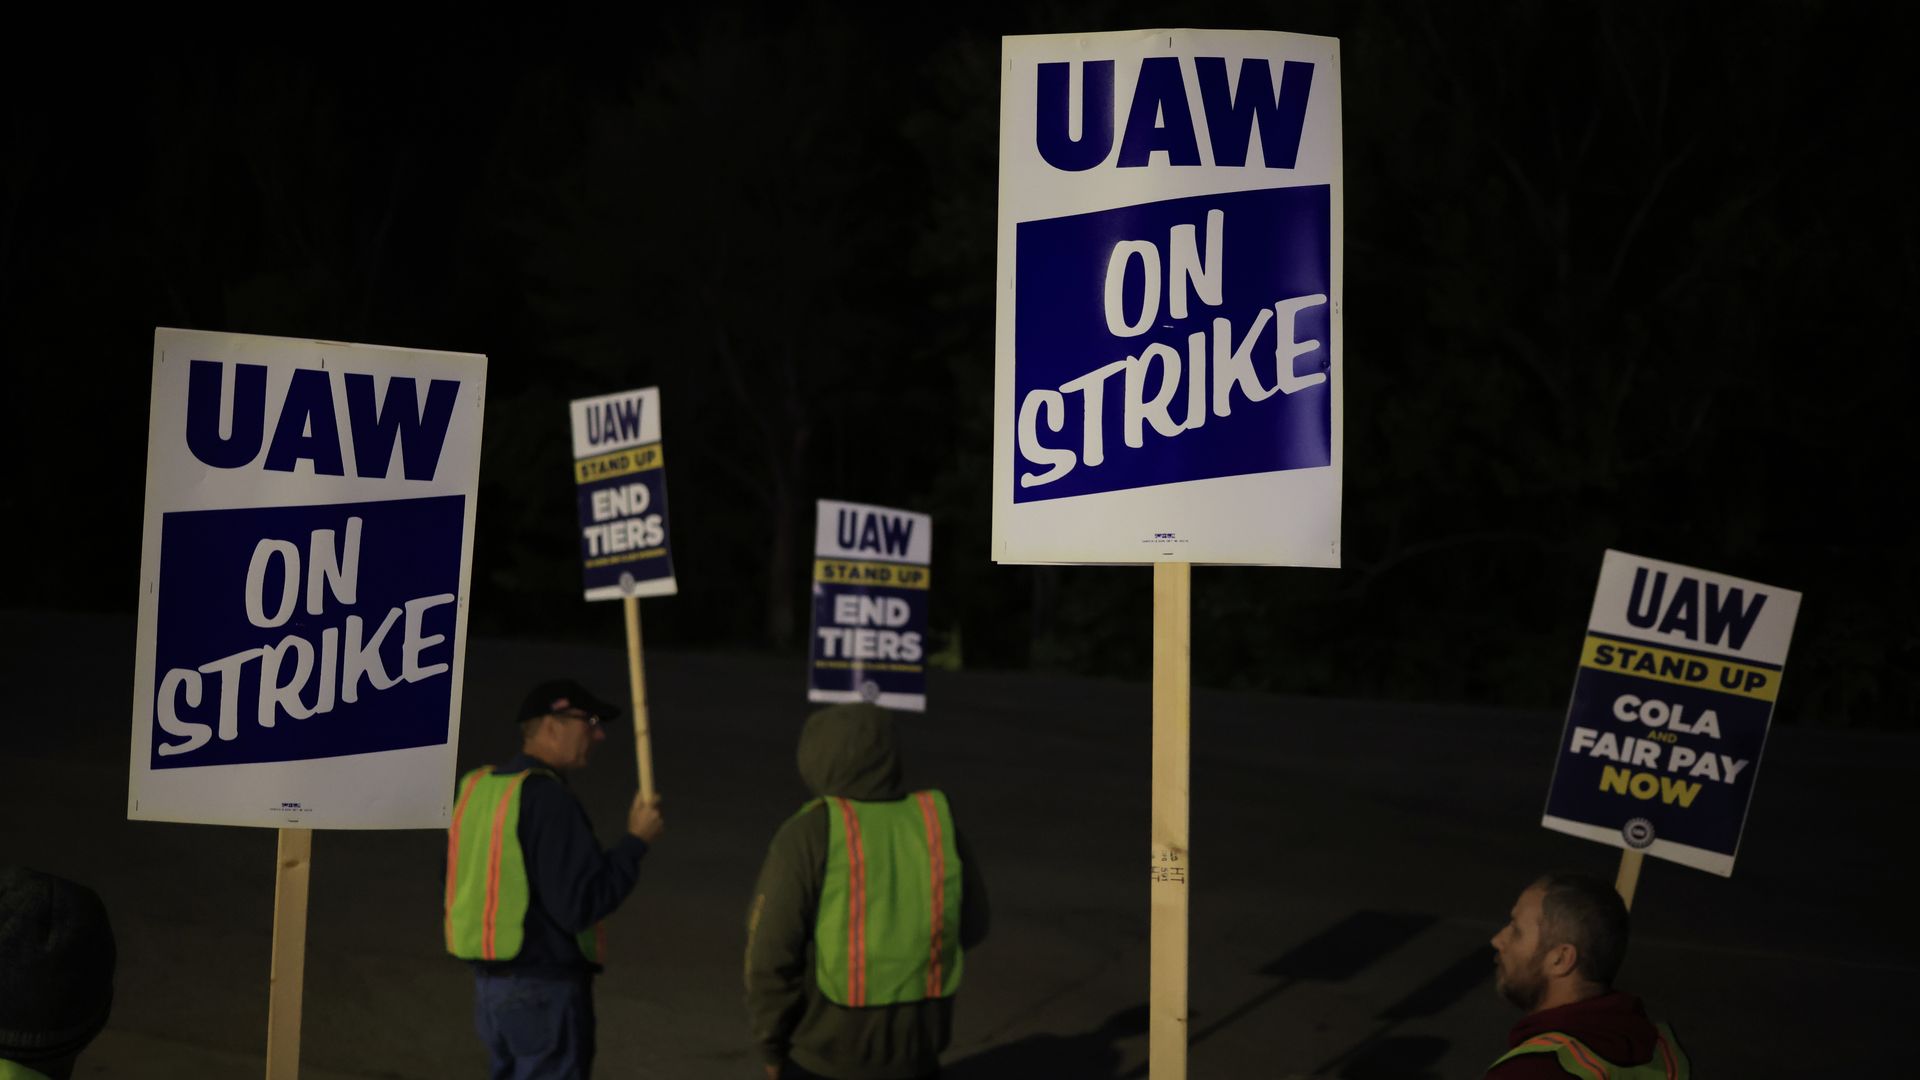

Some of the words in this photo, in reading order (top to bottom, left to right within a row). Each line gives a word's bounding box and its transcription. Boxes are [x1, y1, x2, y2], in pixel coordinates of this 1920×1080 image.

[1035, 57, 1315, 172] UAW
[1103, 208, 1224, 338] ON
[1017, 292, 1328, 488] STRIKE
[185, 358, 462, 482] UAW
[586, 397, 644, 446] UAW
[580, 451, 630, 479] STAND
[636, 450, 657, 467] UP
[591, 482, 650, 522] END
[584, 514, 665, 557] TIERS
[837, 508, 914, 557] UAW
[244, 514, 364, 631] ON
[823, 565, 892, 582] STAND
[898, 571, 923, 583] UP
[834, 594, 910, 627] END
[1626, 567, 1767, 650] UAW
[818, 627, 923, 662] TIERS
[1594, 644, 1709, 682] STAND
[1719, 667, 1767, 692] UP
[155, 592, 457, 757] STRIKE
[1613, 694, 1721, 739] COLA
[1647, 729, 1678, 743] AND
[1569, 727, 1662, 769] FAIR
[1667, 745, 1749, 784] PAY
[1599, 765, 1702, 808] NOW
